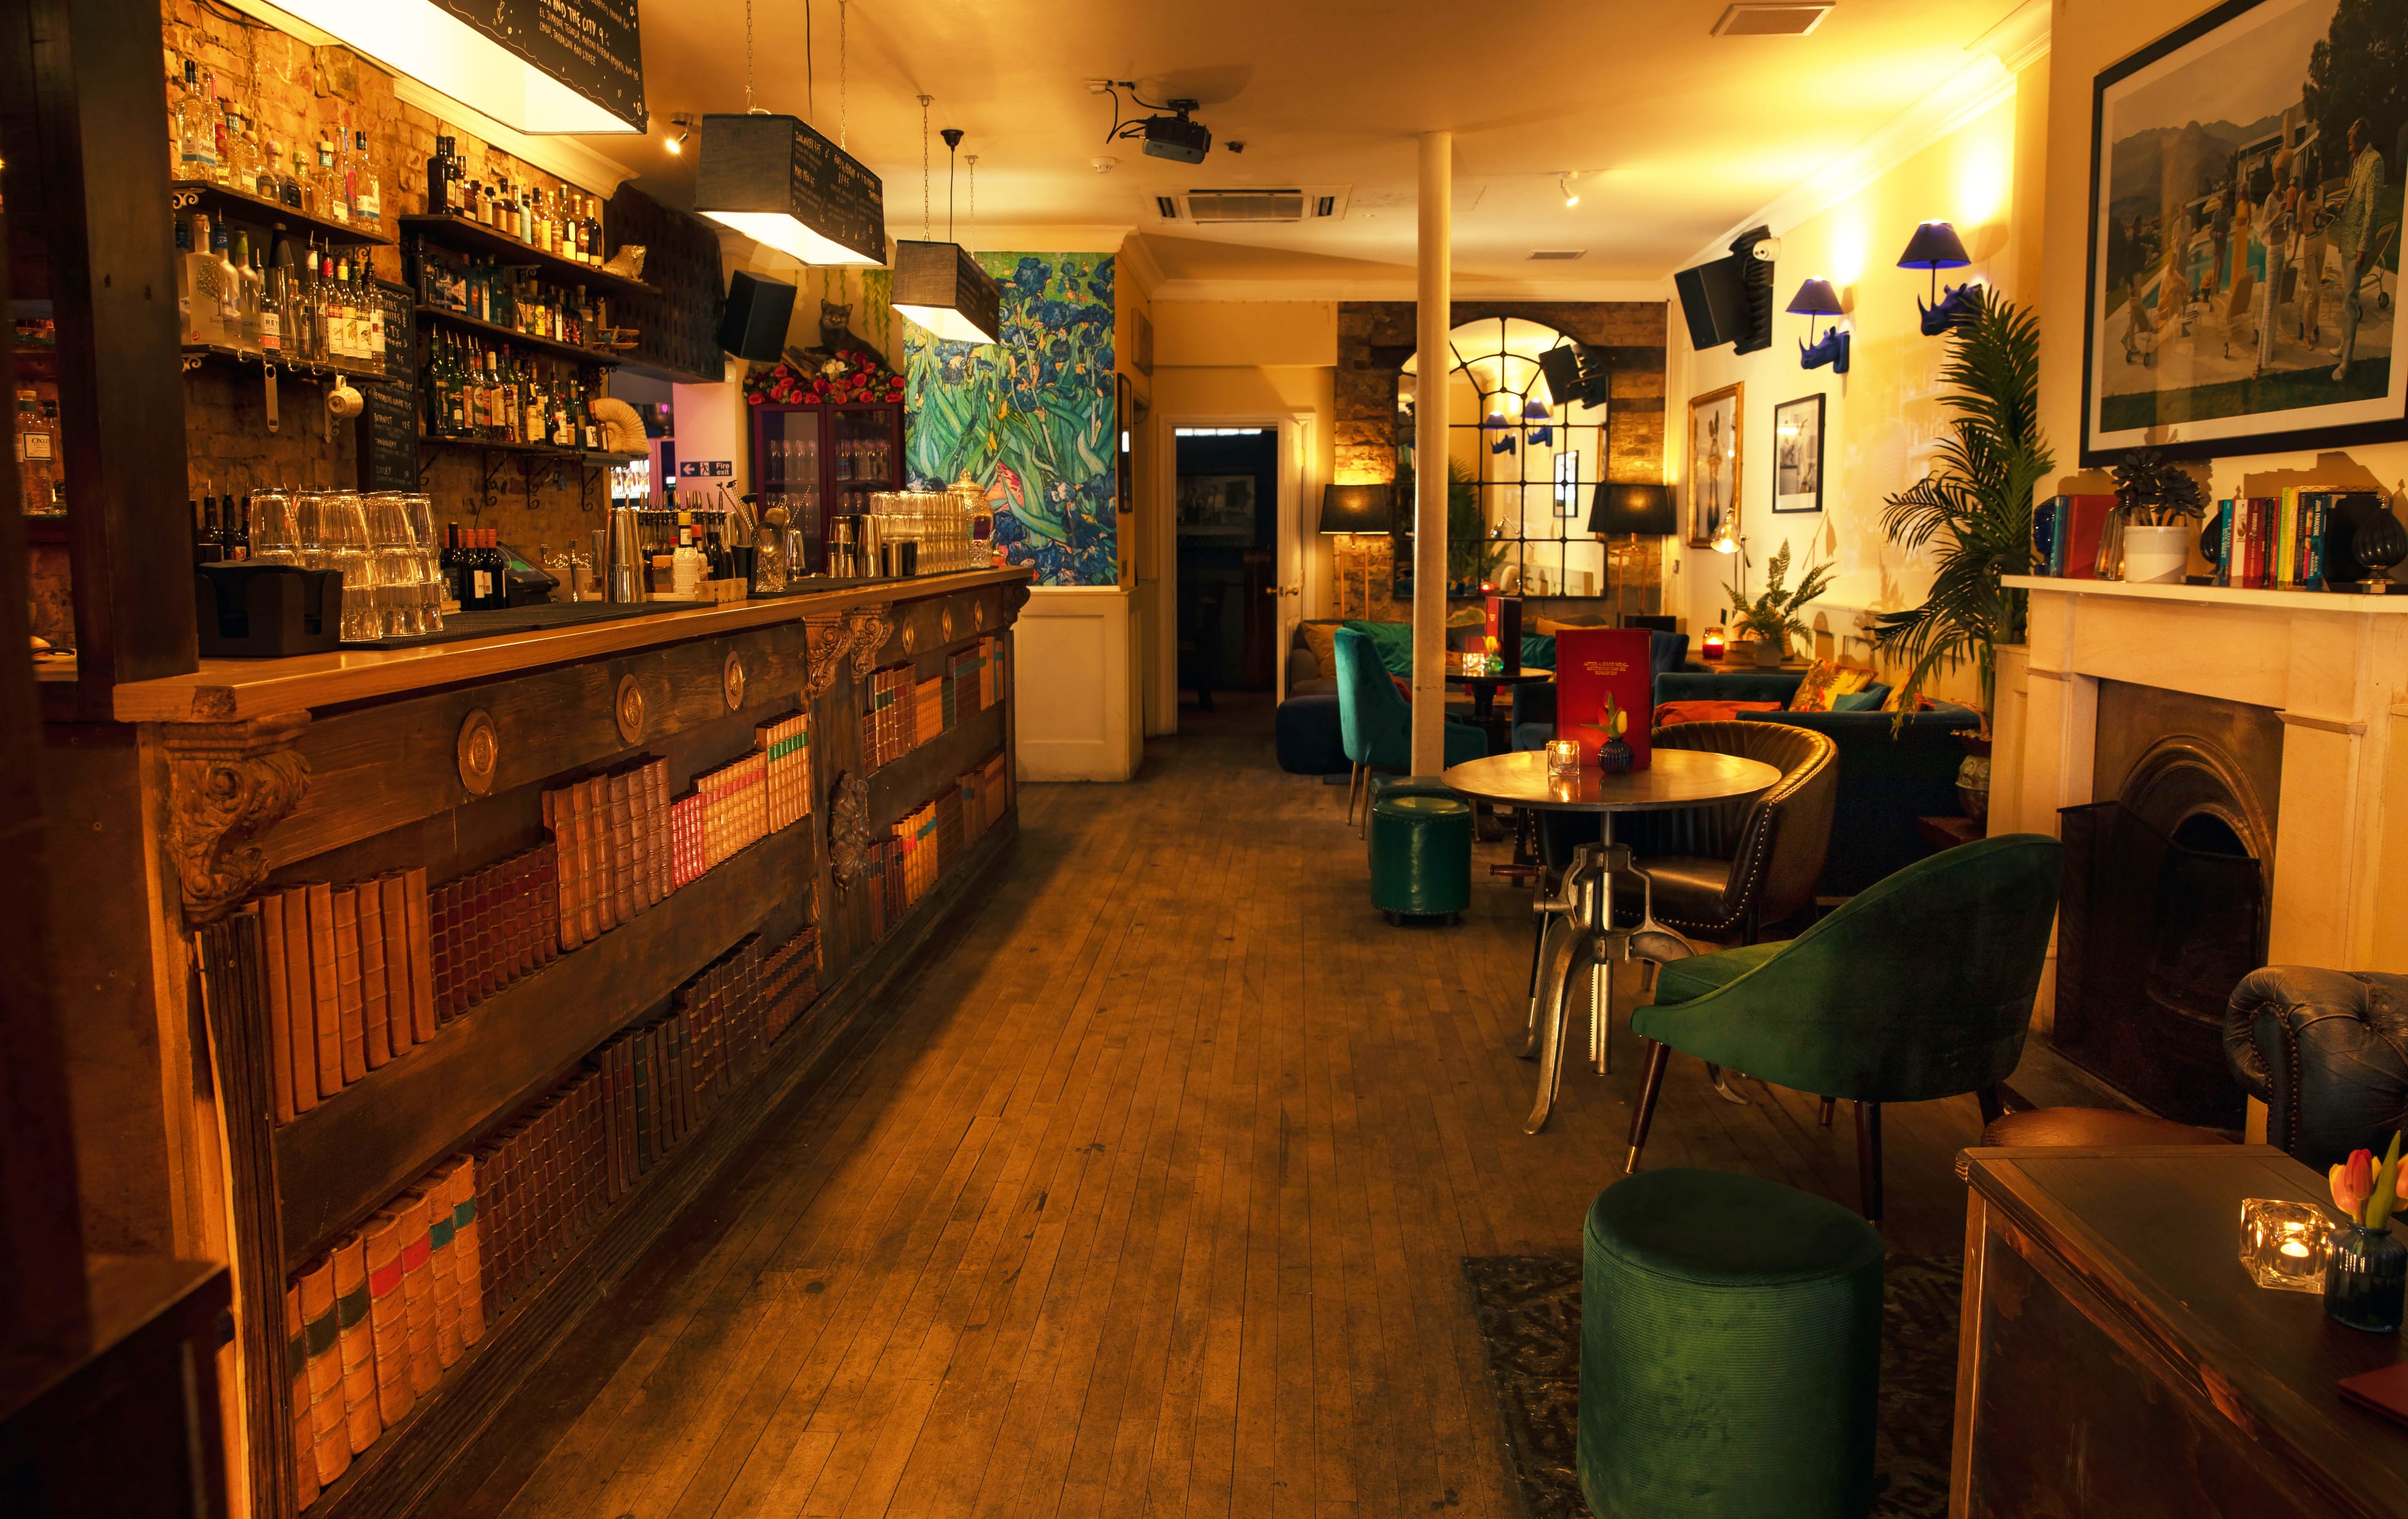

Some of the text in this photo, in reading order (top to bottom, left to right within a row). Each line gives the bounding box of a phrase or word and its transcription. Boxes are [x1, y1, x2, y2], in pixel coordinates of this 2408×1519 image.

[539, 7, 546, 18] EL
[568, 5, 581, 28] THE
[582, 16, 596, 37] CITY
[573, 43, 582, 57] AND
[2313, 512, 2321, 536] FRANCOME
